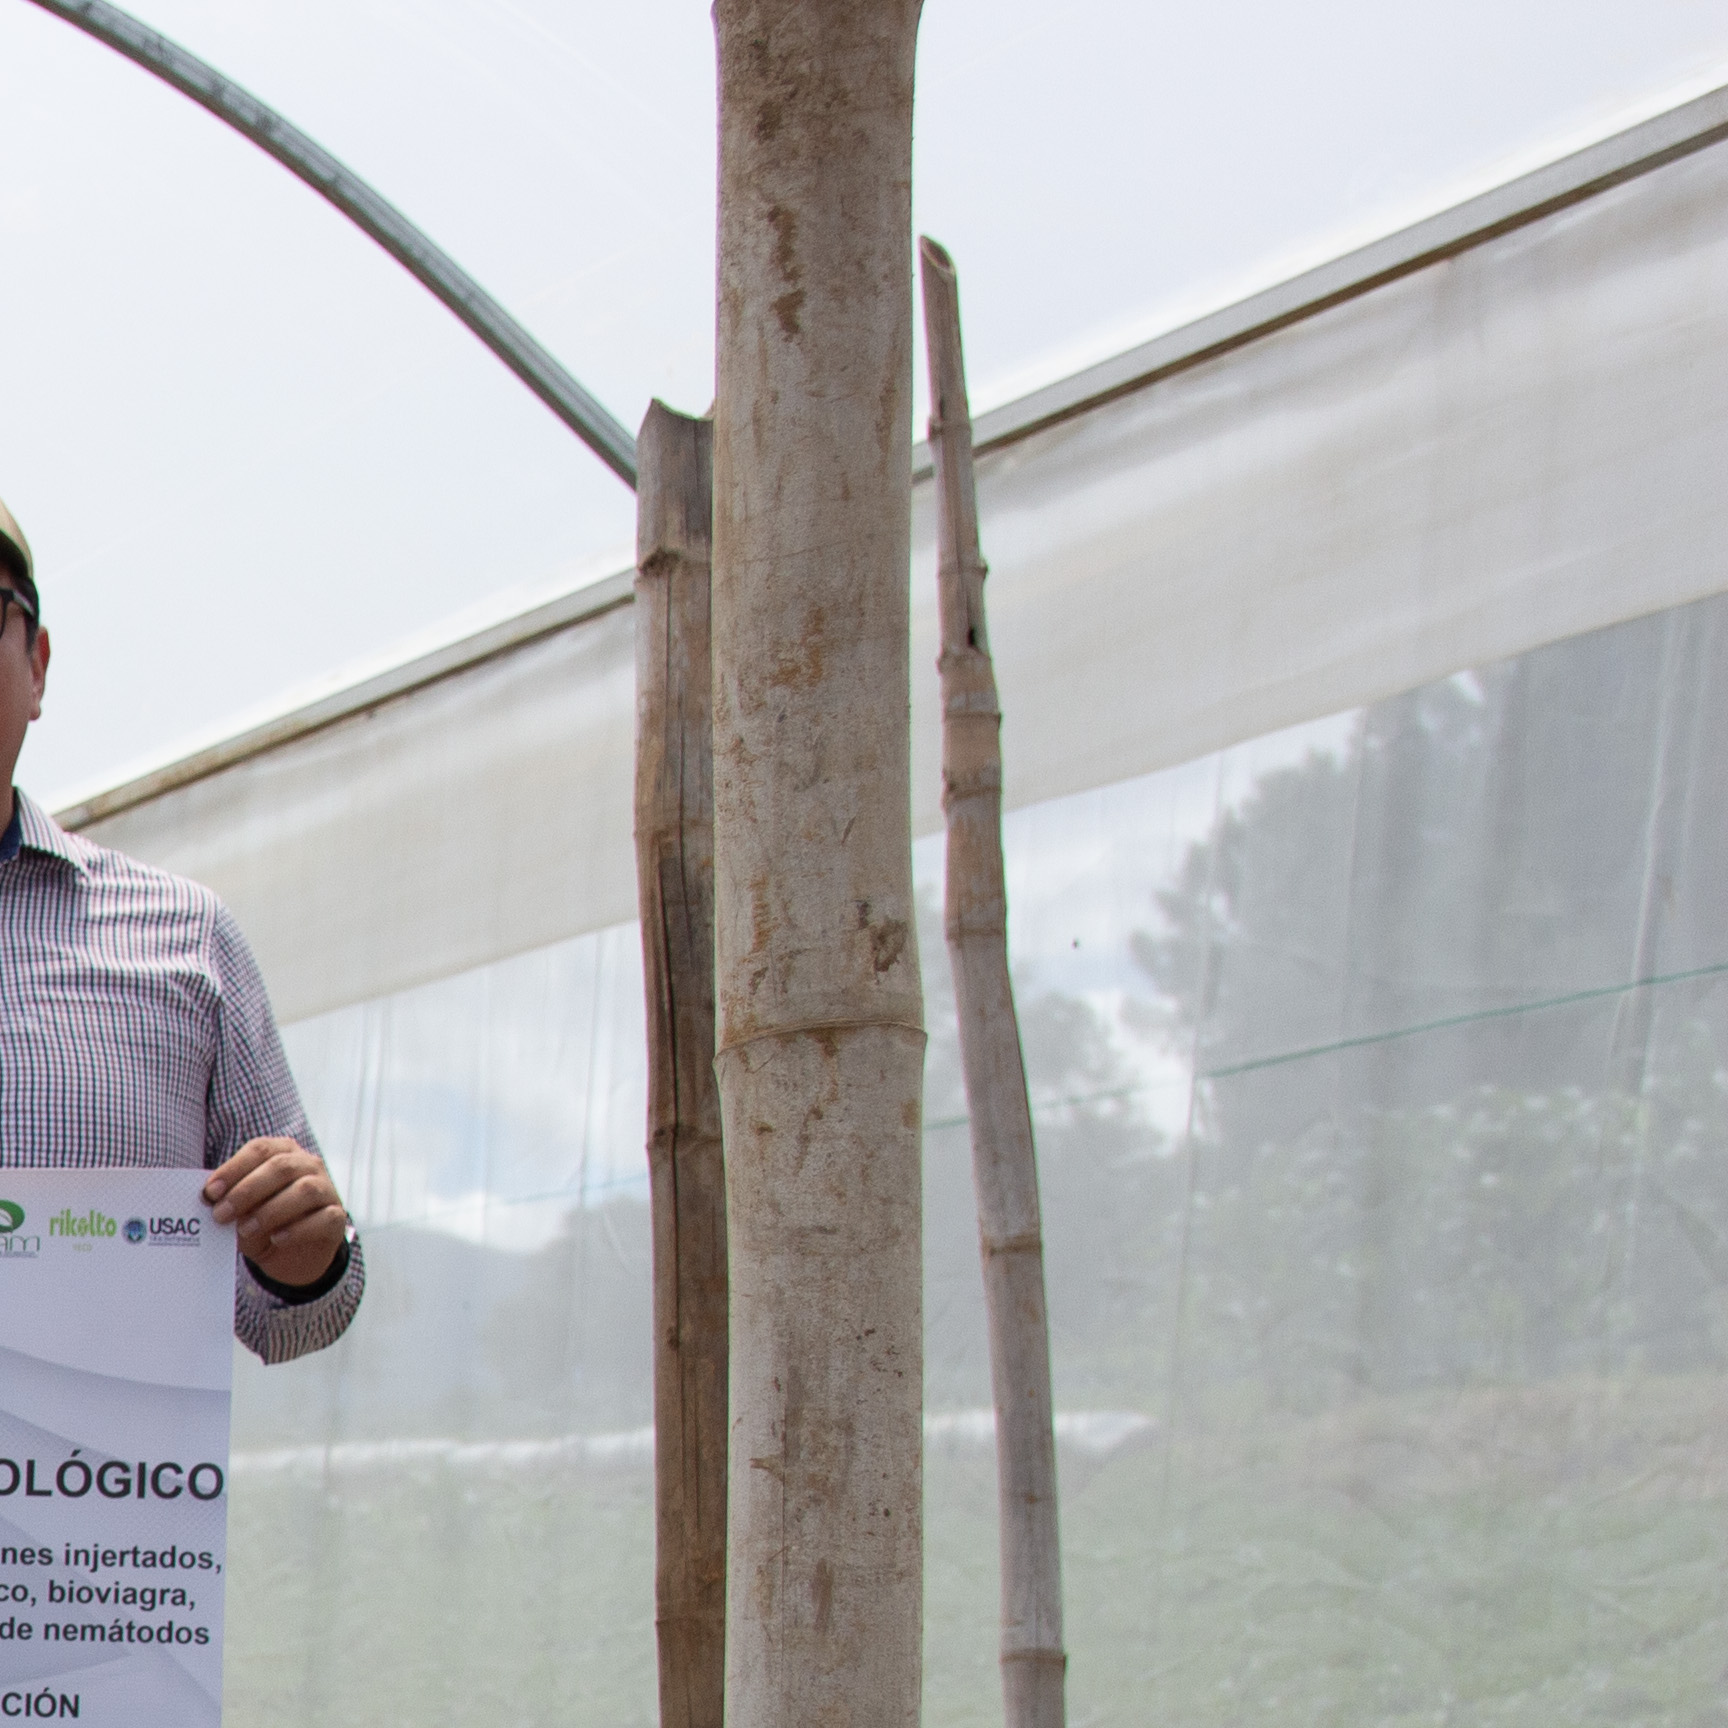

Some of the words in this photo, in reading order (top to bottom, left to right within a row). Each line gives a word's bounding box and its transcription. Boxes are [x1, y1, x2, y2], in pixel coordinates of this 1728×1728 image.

[49, 1208, 118, 1238] rikolto
[150, 1217, 200, 1235] USAC
[64, 1543, 221, 1575] injertados,
[48, 1580, 195, 1613] bioviagra,
[44, 1618, 209, 1646] nemátodos
